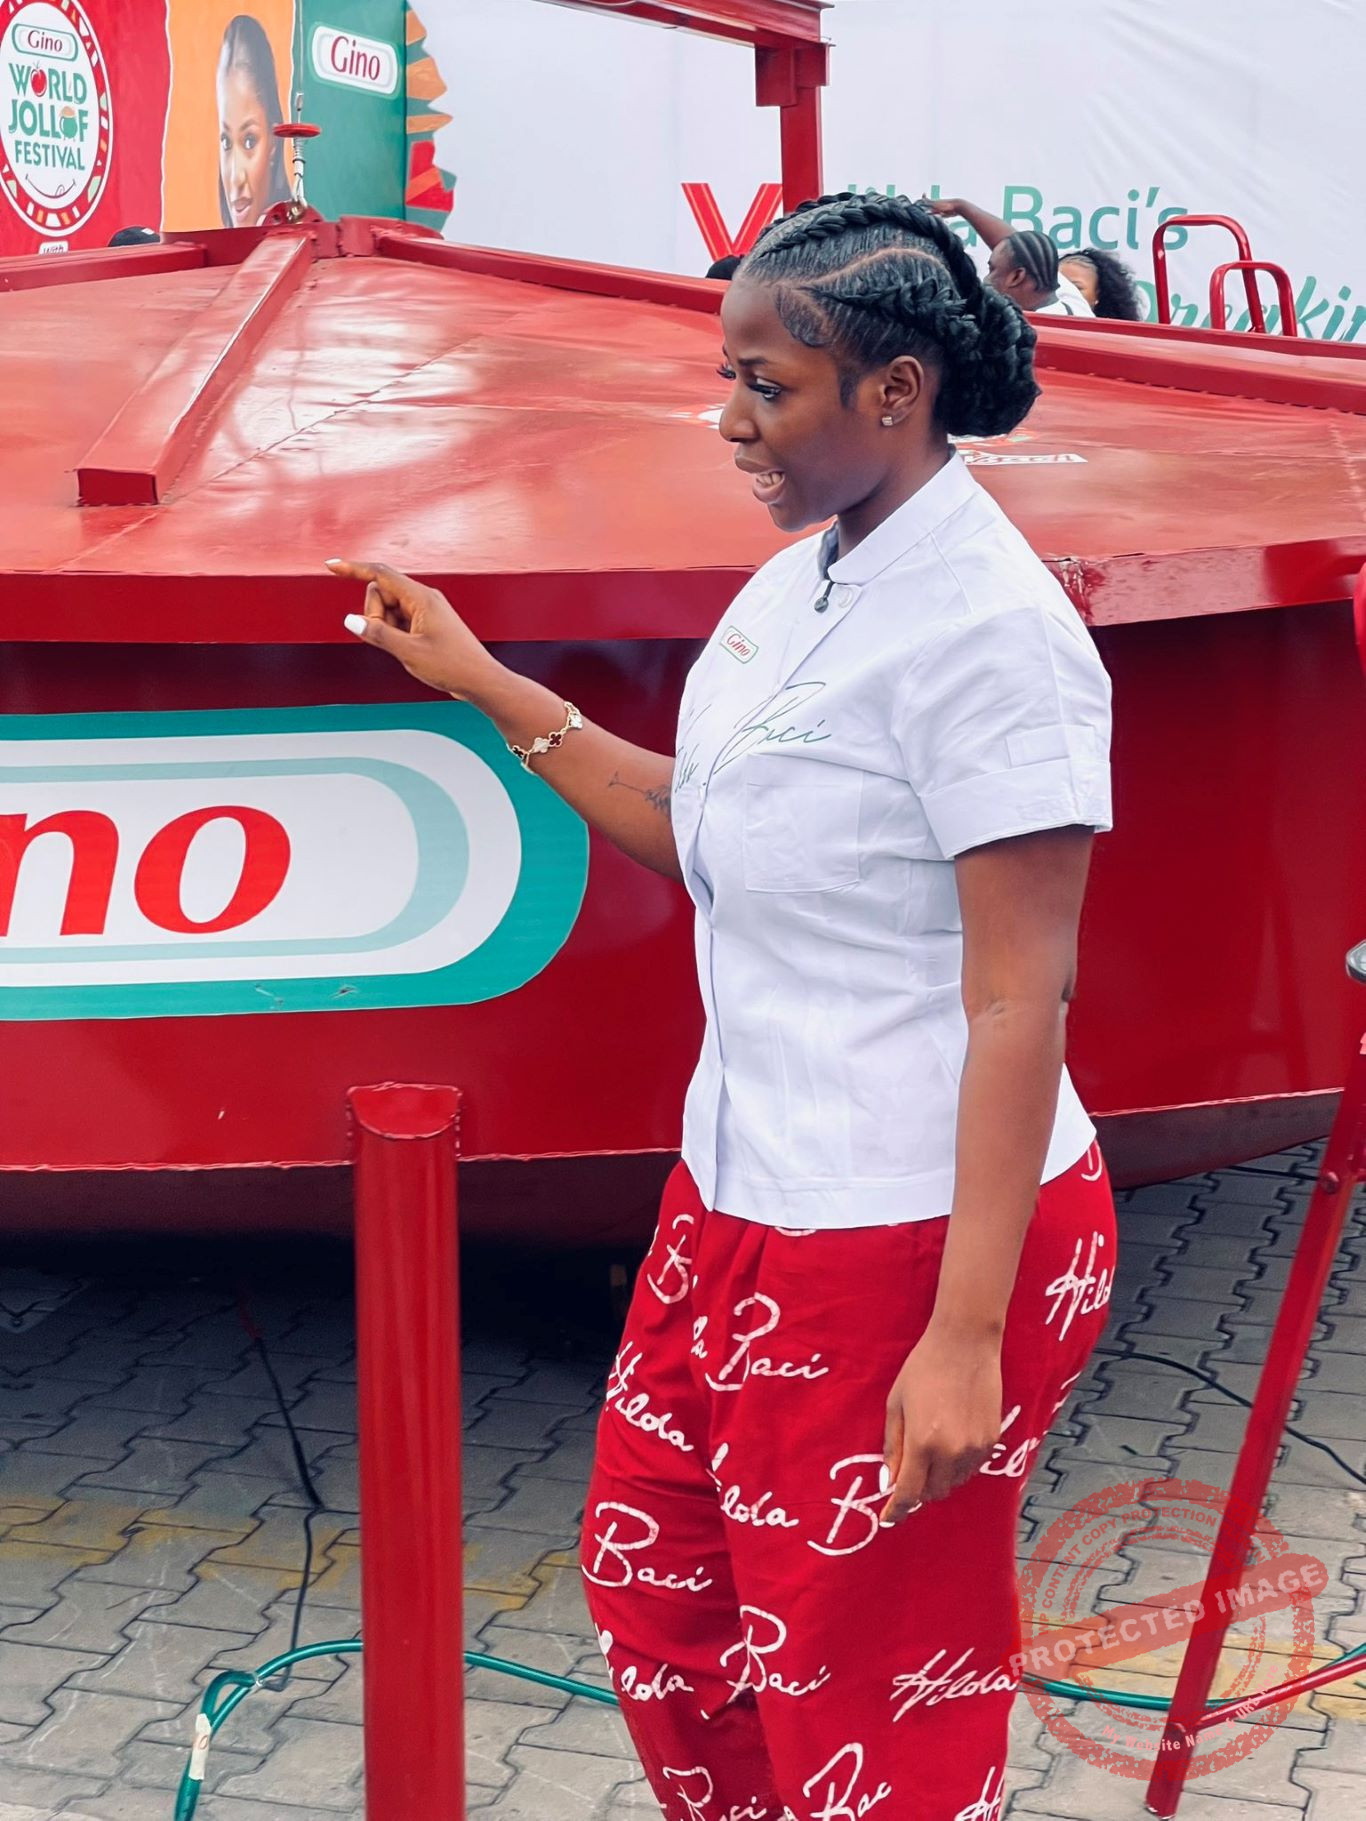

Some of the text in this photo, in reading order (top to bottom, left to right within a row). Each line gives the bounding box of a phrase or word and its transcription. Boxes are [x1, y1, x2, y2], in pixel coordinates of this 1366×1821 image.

[27, 29, 63, 52] Gino
[330, 34, 381, 81] Gino
[15, 140, 85, 170] FESTIVAL
[726, 632, 751, 658] Gino
[705, 1292, 829, 1393] Baci
[581, 1501, 713, 1592] Baci
[719, 1605, 832, 1705] Baci
[889, 1647, 1021, 1723] Hilda
